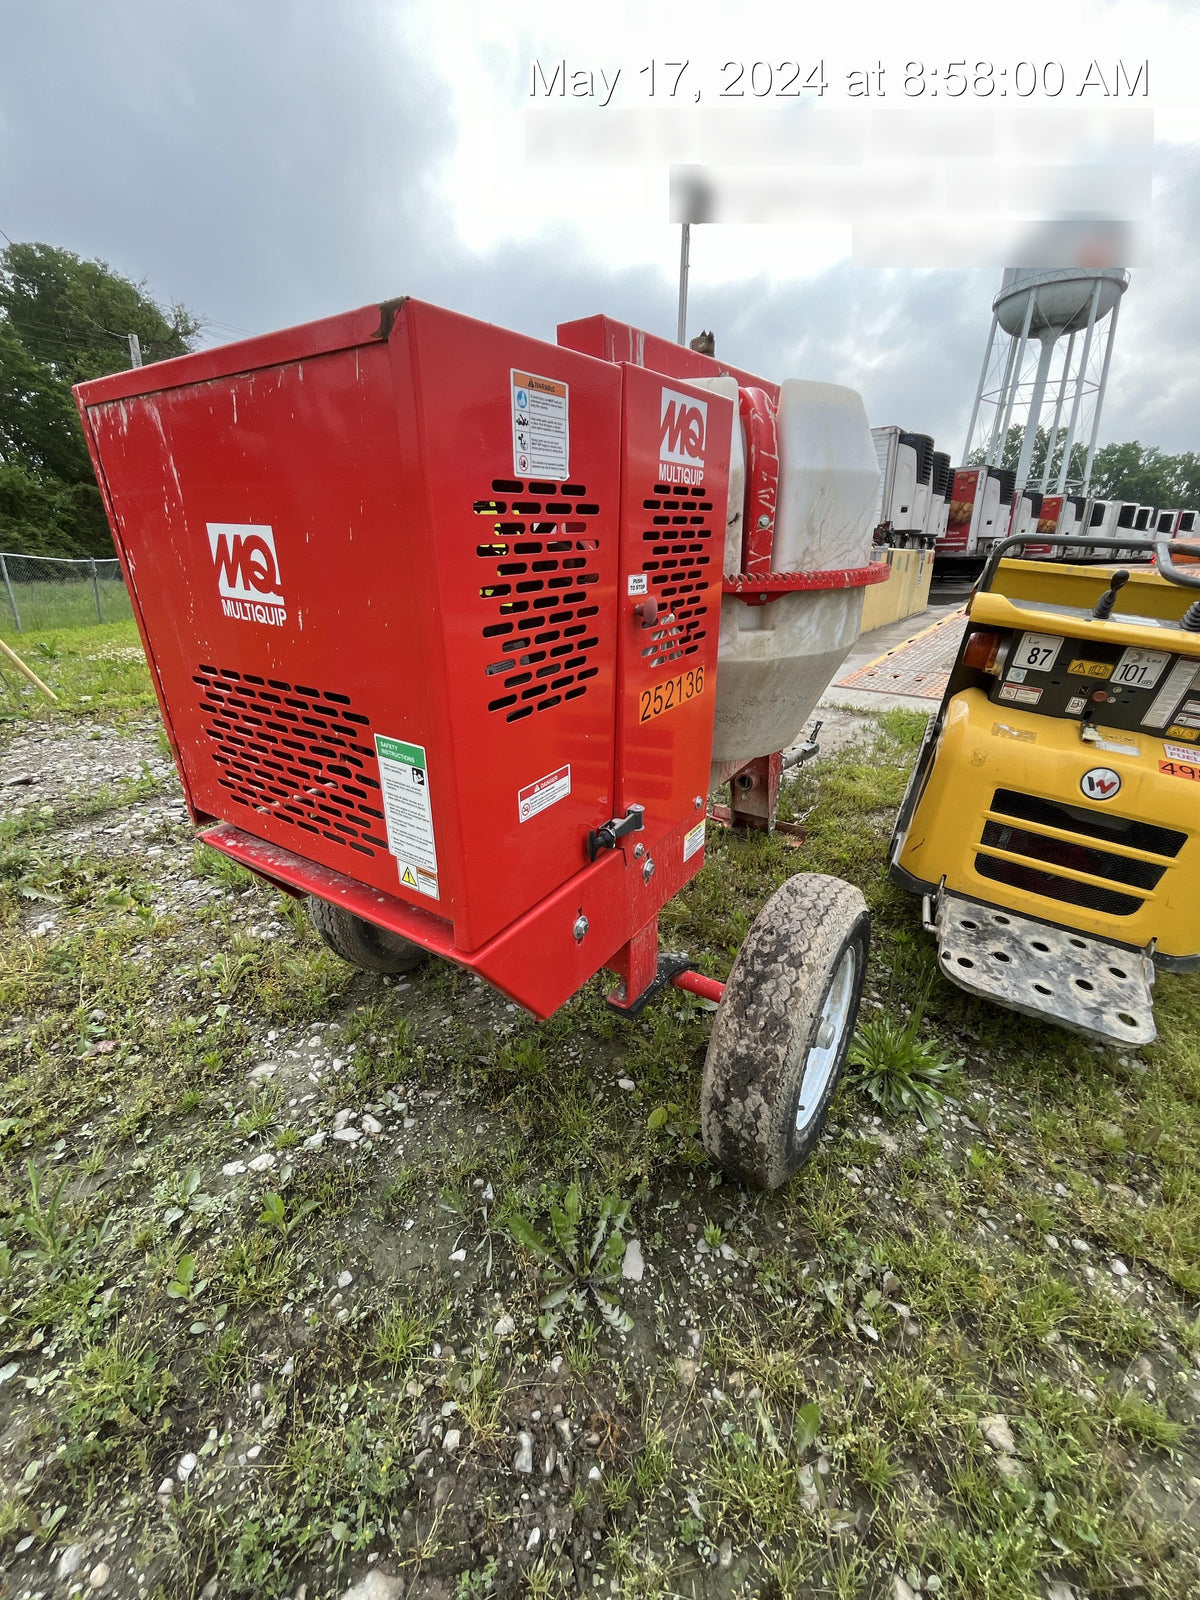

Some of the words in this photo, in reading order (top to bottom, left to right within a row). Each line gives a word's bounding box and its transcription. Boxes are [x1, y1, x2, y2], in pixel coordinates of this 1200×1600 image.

[660, 394, 707, 463] MQ
[658, 463, 704, 486] MULTIQUIP
[211, 529, 284, 600] MQ
[221, 598, 287, 627] MULTIQUIP
[1027, 647, 1053, 666] 87
[1119, 663, 1148, 683] 101
[640, 666, 704, 722] 252136
[380, 741, 398, 751] SAFETY
[381, 748, 416, 764] INSTRUCTIONS
[1161, 762, 1200, 779] 49
[540, 774, 559, 789] DANGER
